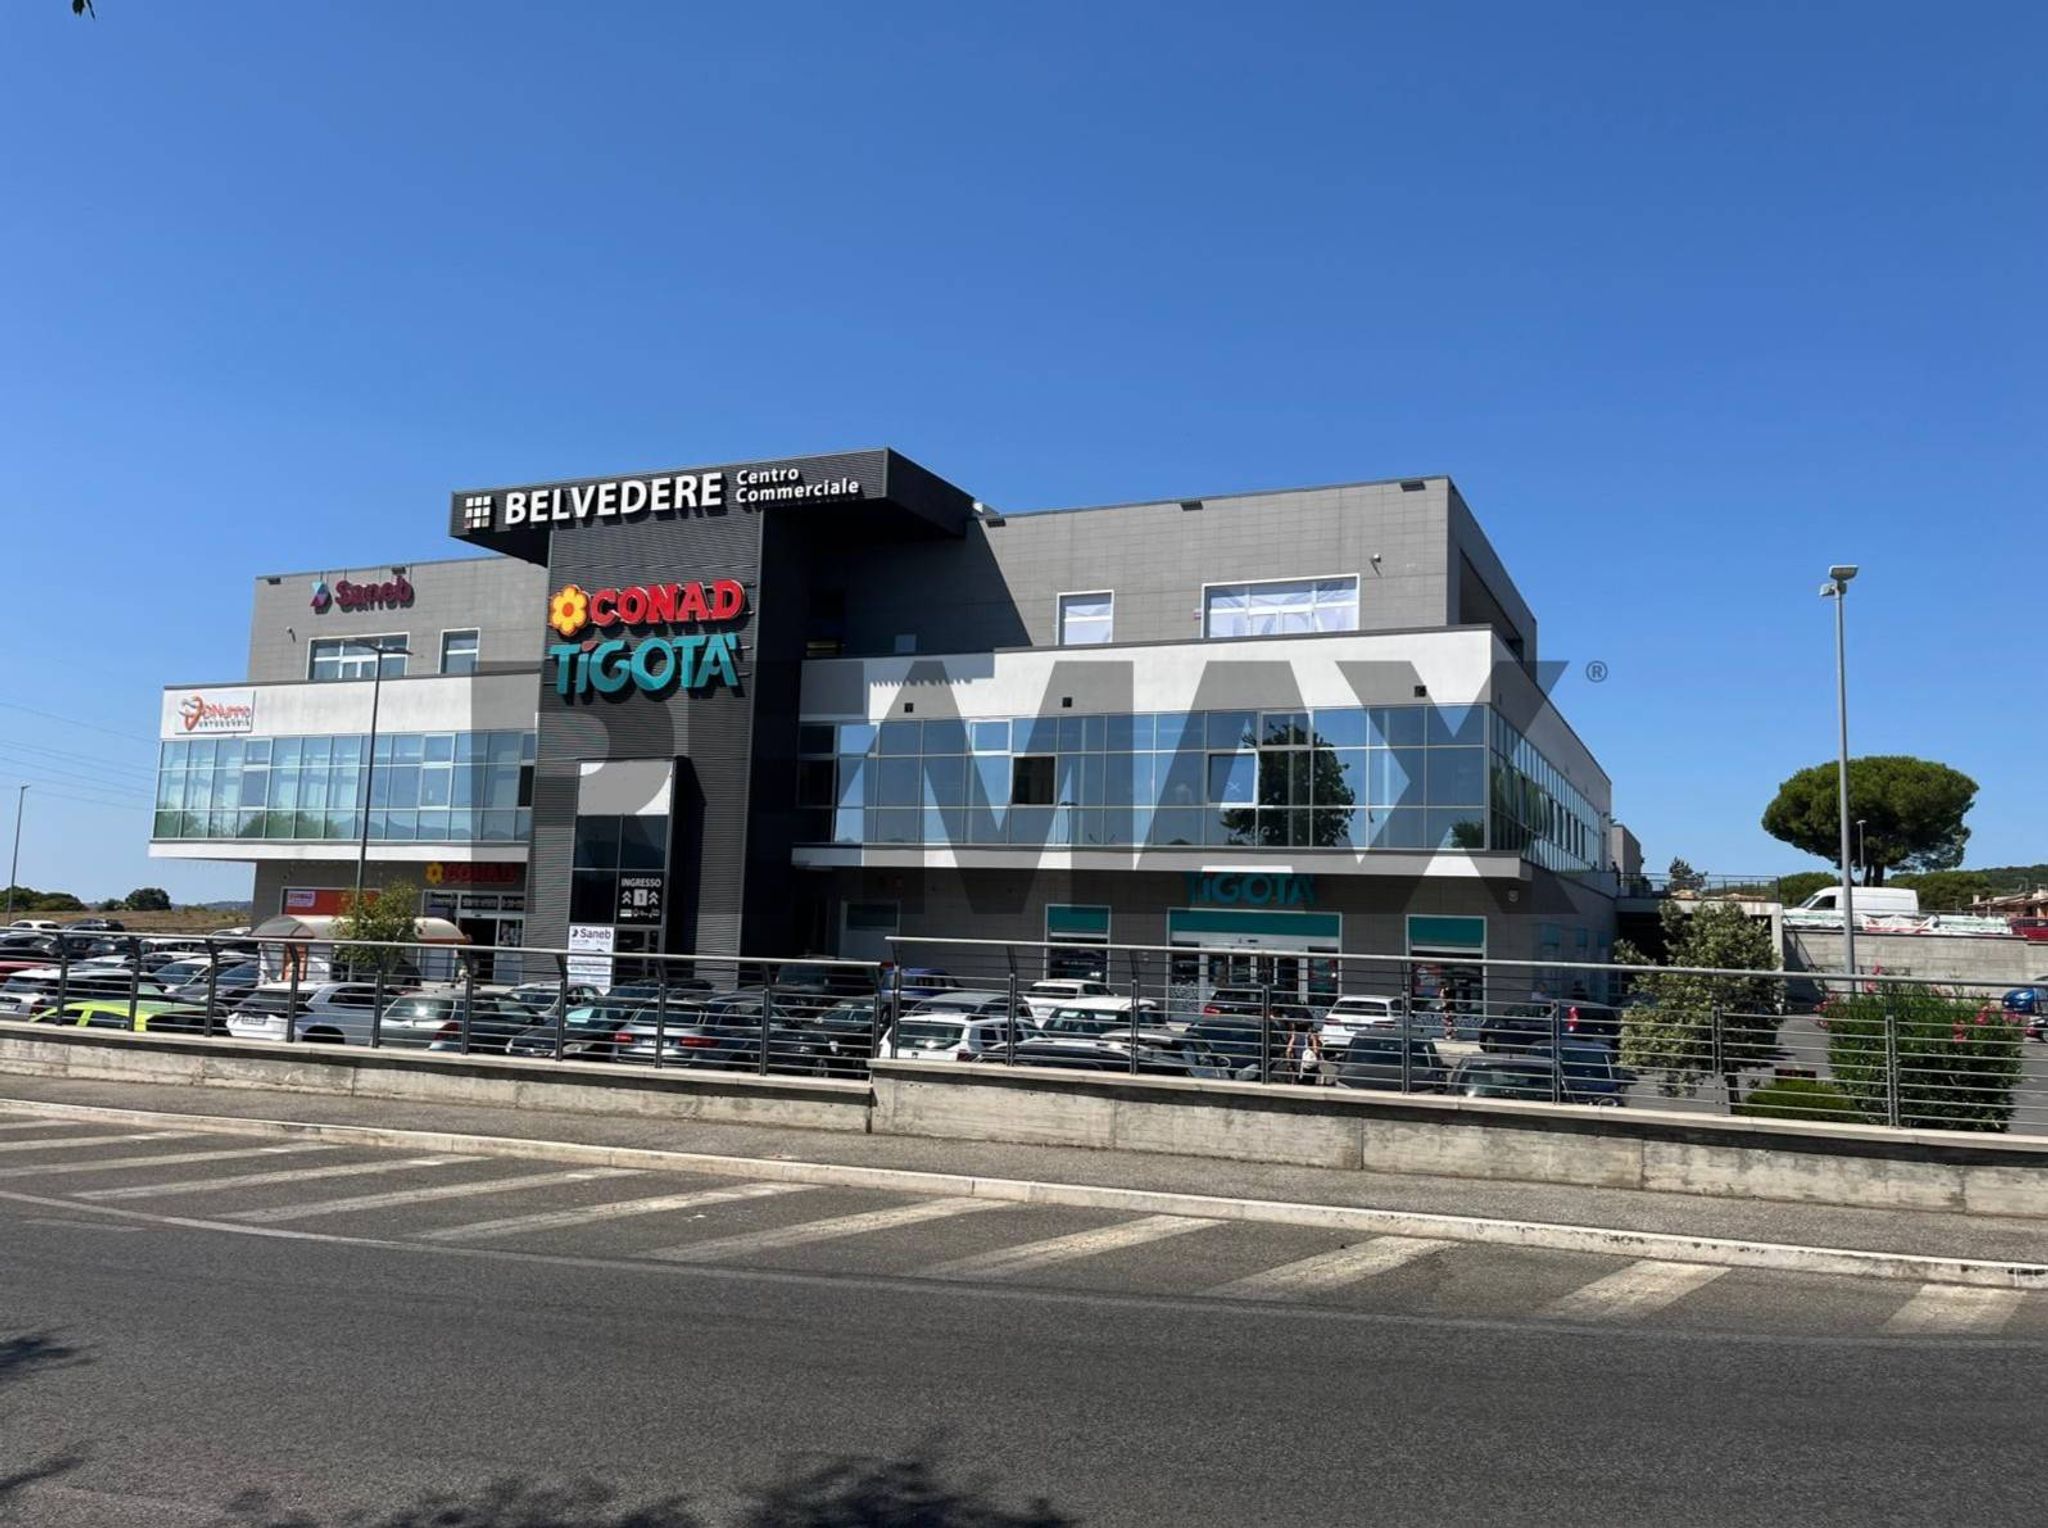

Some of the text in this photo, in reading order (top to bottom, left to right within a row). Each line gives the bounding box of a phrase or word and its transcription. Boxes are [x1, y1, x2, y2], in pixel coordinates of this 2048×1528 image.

[736, 468, 799, 485] Centro
[504, 472, 723, 525] BELVEDERE
[735, 477, 860, 503] Commerciale
[335, 575, 415, 606] Saneb
[590, 578, 746, 627] CONAD
[621, 878, 662, 888] INGRESSO
[579, 927, 612, 940] Saneb
